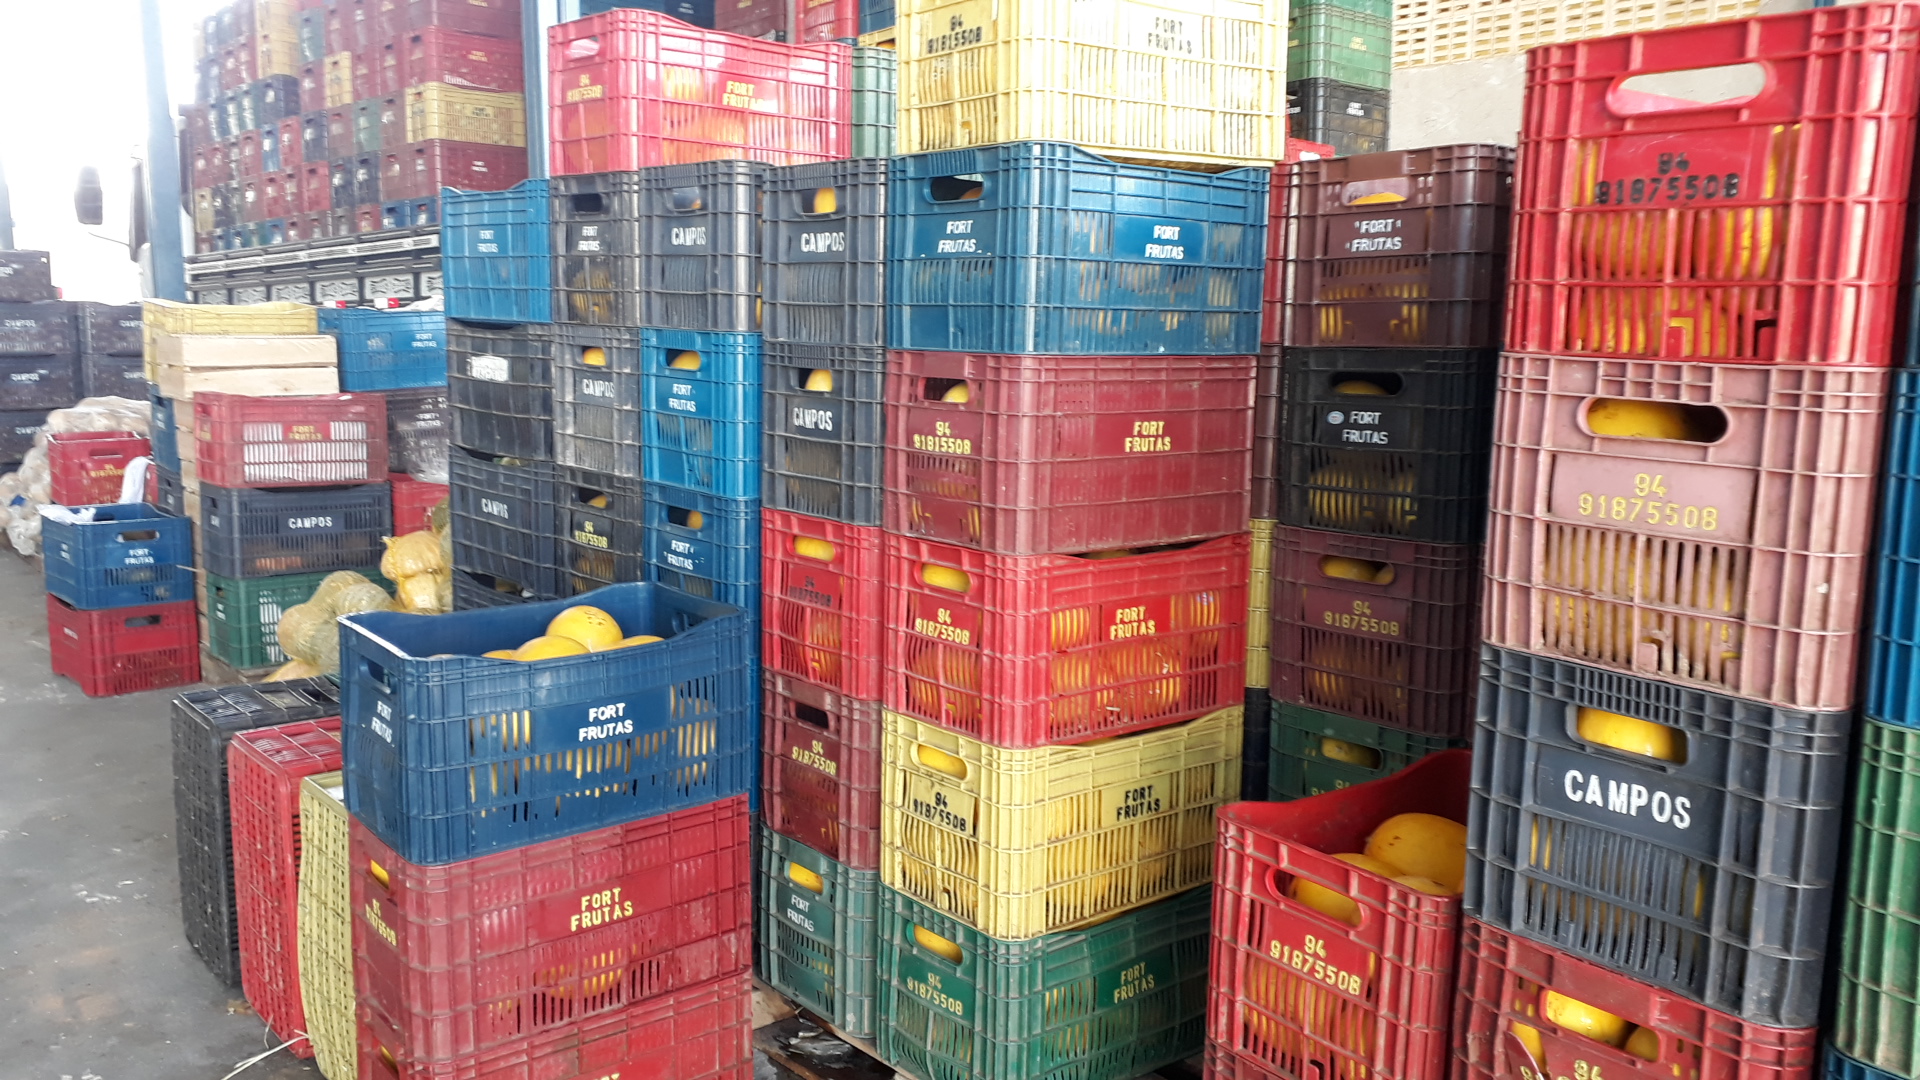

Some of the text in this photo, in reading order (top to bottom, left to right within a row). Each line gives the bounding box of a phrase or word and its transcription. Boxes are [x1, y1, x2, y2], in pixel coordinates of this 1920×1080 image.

[1155, 17, 1184, 36] FORT
[1147, 33, 1193, 55] FRUTAS
[726, 80, 756, 97] FORT
[1658, 151, 1690, 175] 94
[945, 219, 974, 235] FORT
[1153, 224, 1181, 241] FORT
[1360, 218, 1395, 235] FORT
[670, 226, 706, 247] CAMPOS
[801, 231, 845, 253] CAMPOS
[937, 238, 977, 254] FRUTAS
[1350, 236, 1402, 253] FRUTAS
[1144, 242, 1185, 260] FRUTAS
[581, 377, 616, 399] CAMPOS
[672, 382, 692, 396] FORT
[667, 397, 696, 413] FRUTAS
[792, 406, 833, 432] CAMPOS
[1349, 410, 1383, 425] FORT
[1132, 420, 1165, 437] FORT
[1342, 428, 1390, 446] FRUTAS
[1124, 435, 1171, 454] FRUTAS
[1634, 472, 1668, 499] 94
[480, 497, 509, 520] CAMPOS
[288, 516, 333, 529] CAMPOS
[936, 606, 952, 625] 94
[1115, 605, 1147, 623] FORT
[1352, 599, 1372, 617] 94
[1109, 620, 1156, 642] FRUTAS
[588, 702, 626, 723] FORT
[578, 718, 635, 743] FRUTAS
[811, 739, 824, 757] 94
[934, 791, 948, 810] 94
[1124, 784, 1154, 804] FORT
[1563, 768, 1692, 830] CAMPOS
[1116, 797, 1161, 823] FRUTAS
[580, 887, 622, 911] FORT
[791, 893, 811, 913] FORT
[569, 900, 634, 932] FRUTAS
[786, 907, 815, 932] FRUTAS
[1304, 933, 1327, 959] 94
[927, 971, 943, 990] 94
[1120, 961, 1146, 986] FORT
[1113, 973, 1155, 1005] FRUTAS
